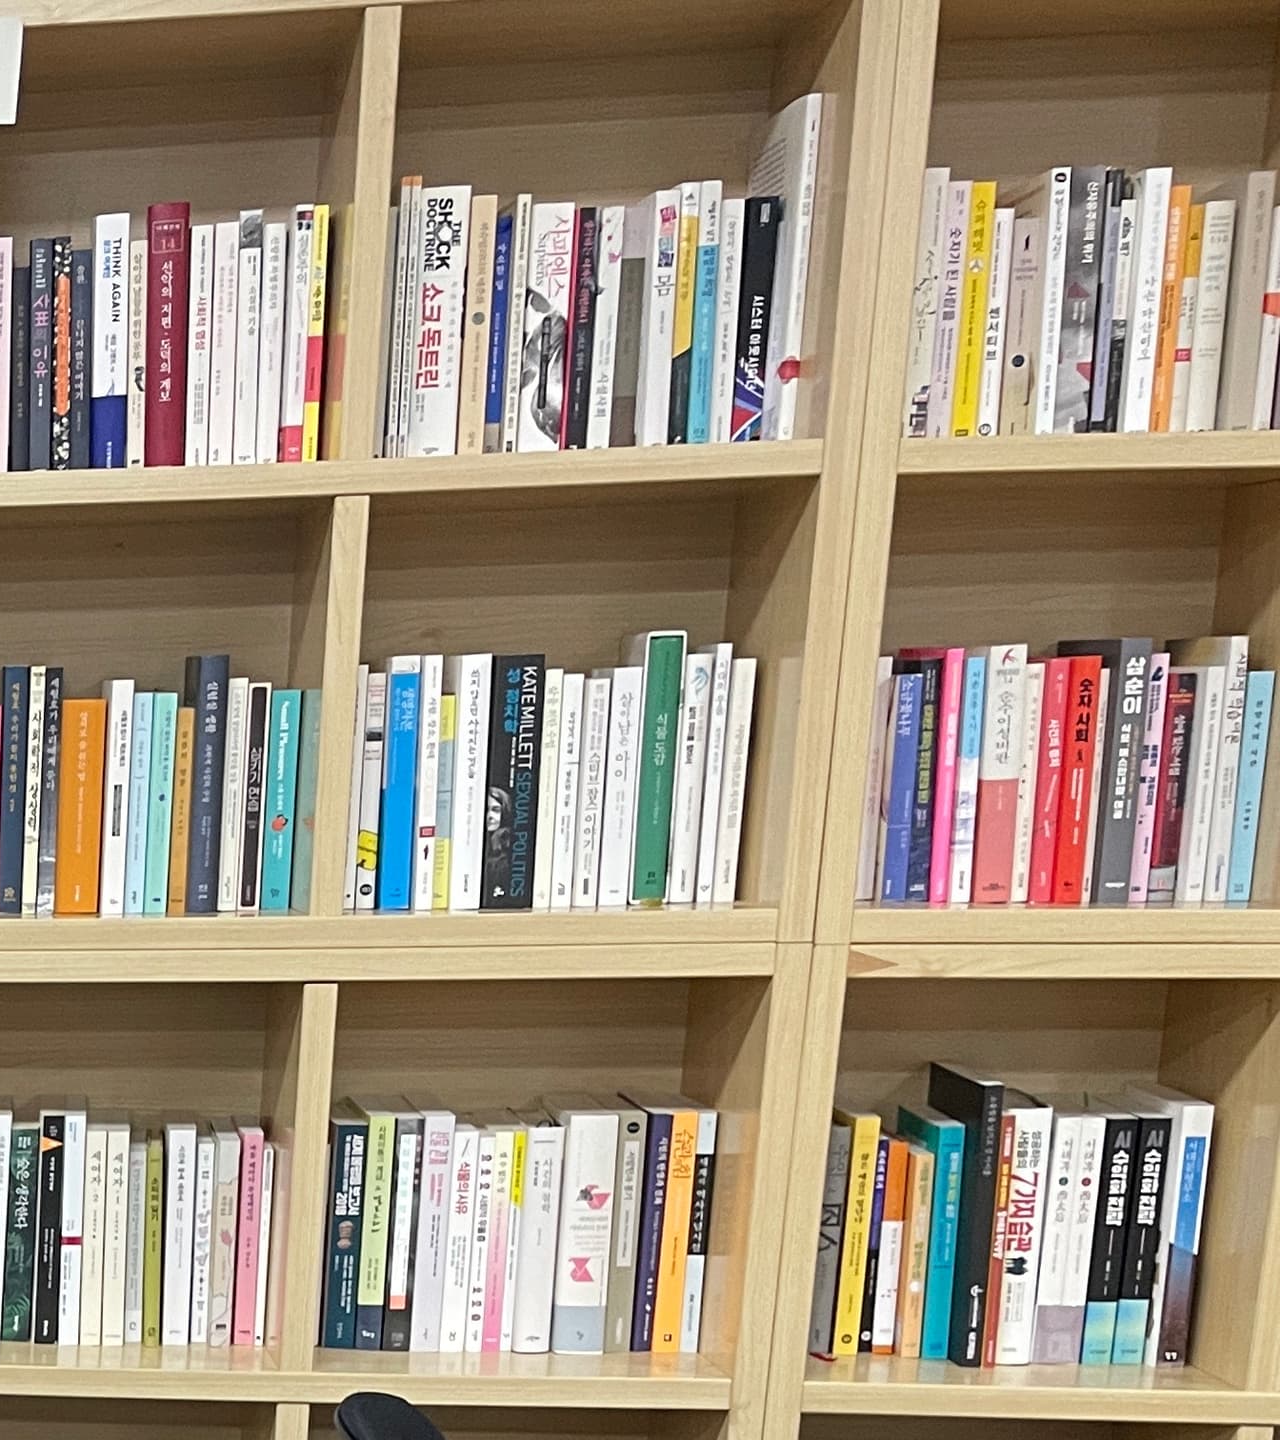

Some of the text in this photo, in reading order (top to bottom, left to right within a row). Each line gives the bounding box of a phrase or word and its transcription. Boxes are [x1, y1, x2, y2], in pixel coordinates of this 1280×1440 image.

[423, 198, 438, 272] DOCTRINE
[438, 198, 454, 269] SHOCK
[451, 221, 461, 246] THE
[1081, 181, 1100, 264] 신자유주의의 위기
[111, 237, 123, 322] THINK AGAIN
[533, 232, 549, 287] Sapiens
[546, 215, 571, 298] 사피엔스
[653, 274, 674, 297] 몸
[33, 293, 50, 379] 사표의 이유
[159, 260, 174, 402] 선악의 저편 도덕의 계보
[194, 296, 207, 351] 사회적 영성
[417, 282, 444, 389] 쇼크 독트린
[749, 295, 766, 330] 시스터
[507, 668, 521, 683] 성
[1123, 656, 1146, 715] 삼순이
[205, 714, 218, 733] 생활
[401, 687, 415, 732] 생명자본
[517, 666, 538, 770] KATE MILLETT
[897, 676, 917, 738] 소금꽃나무
[1048, 719, 1061, 747] 사건의
[1074, 678, 1093, 743] 숫자 사회
[1168, 714, 1185, 776] 섬에 있는 서점
[510, 772, 532, 897] SEXUAL POLITICS
[1015, 1130, 1028, 1169] 사람들의
[1028, 1130, 1042, 1169] 성공하는
[13, 1158, 30, 1229] 숲은 생각한다
[455, 1161, 471, 1215] 식물의 사유
[1005, 1172, 1039, 1253] 7가지 습관
